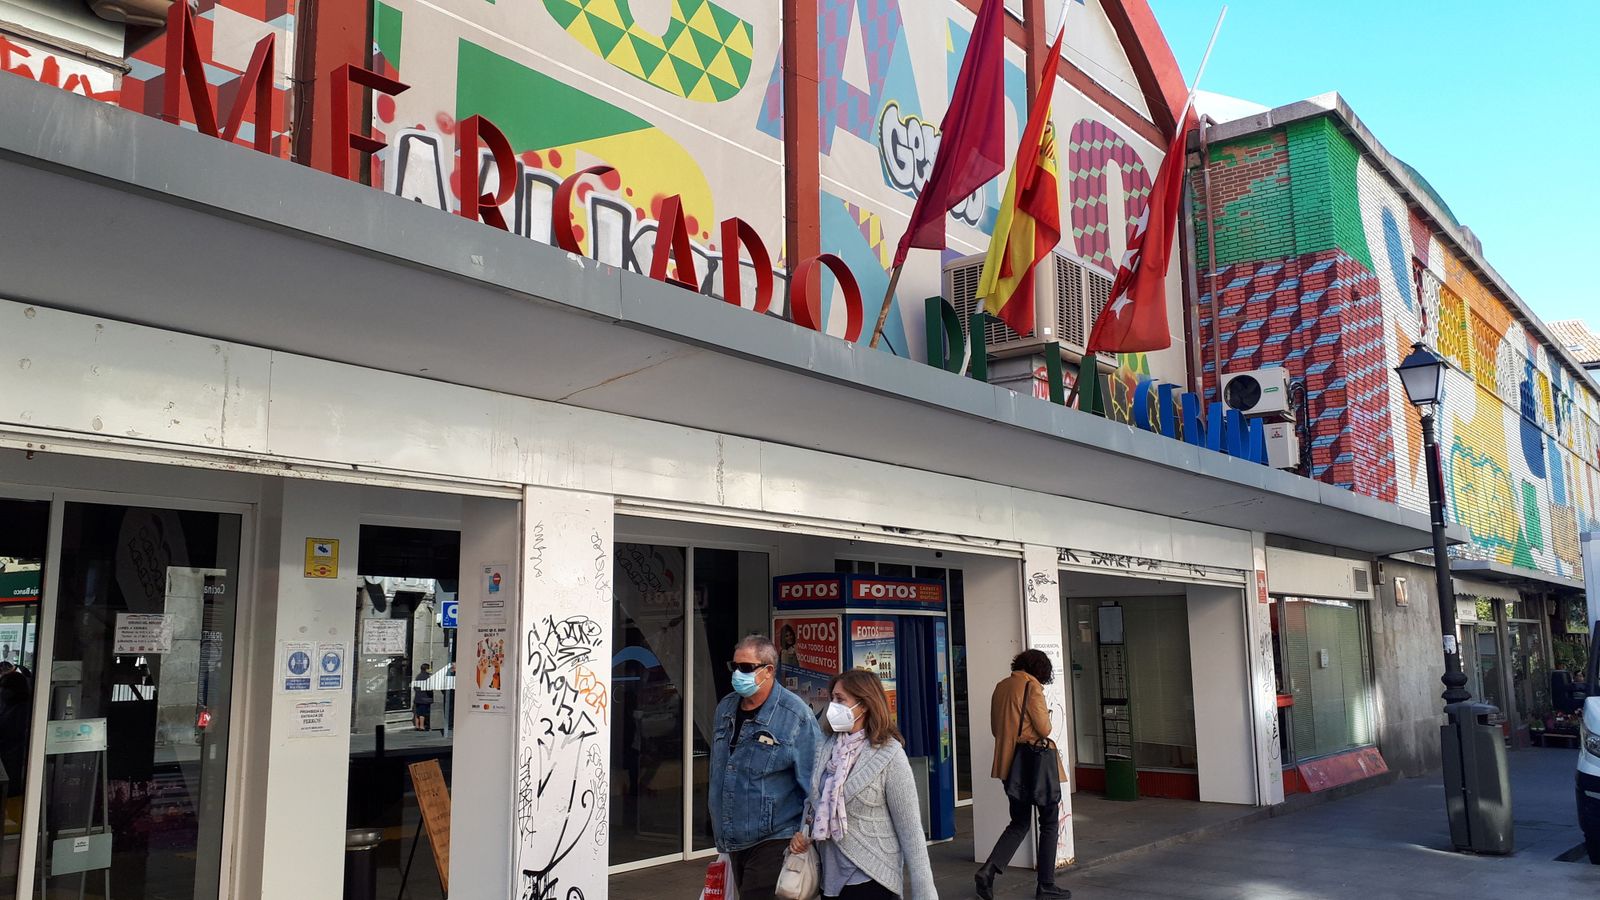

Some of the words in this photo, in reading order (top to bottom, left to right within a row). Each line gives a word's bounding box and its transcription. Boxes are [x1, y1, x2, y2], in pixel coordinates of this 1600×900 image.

[163, 0, 864, 343] MERCADO
[924, 296, 1002, 383] DE
[1045, 342, 1109, 419] LA
[1132, 378, 1270, 467] CEBADA
[781, 583, 838, 598] FOTOS
[859, 583, 917, 599] FOTOS
[797, 622, 836, 641] FOTOS
[857, 625, 879, 638] FOTOS
[808, 643, 825, 652] TODOS
[825, 645, 836, 654] LOS
[797, 653, 837, 669] DOCUMENTOS
